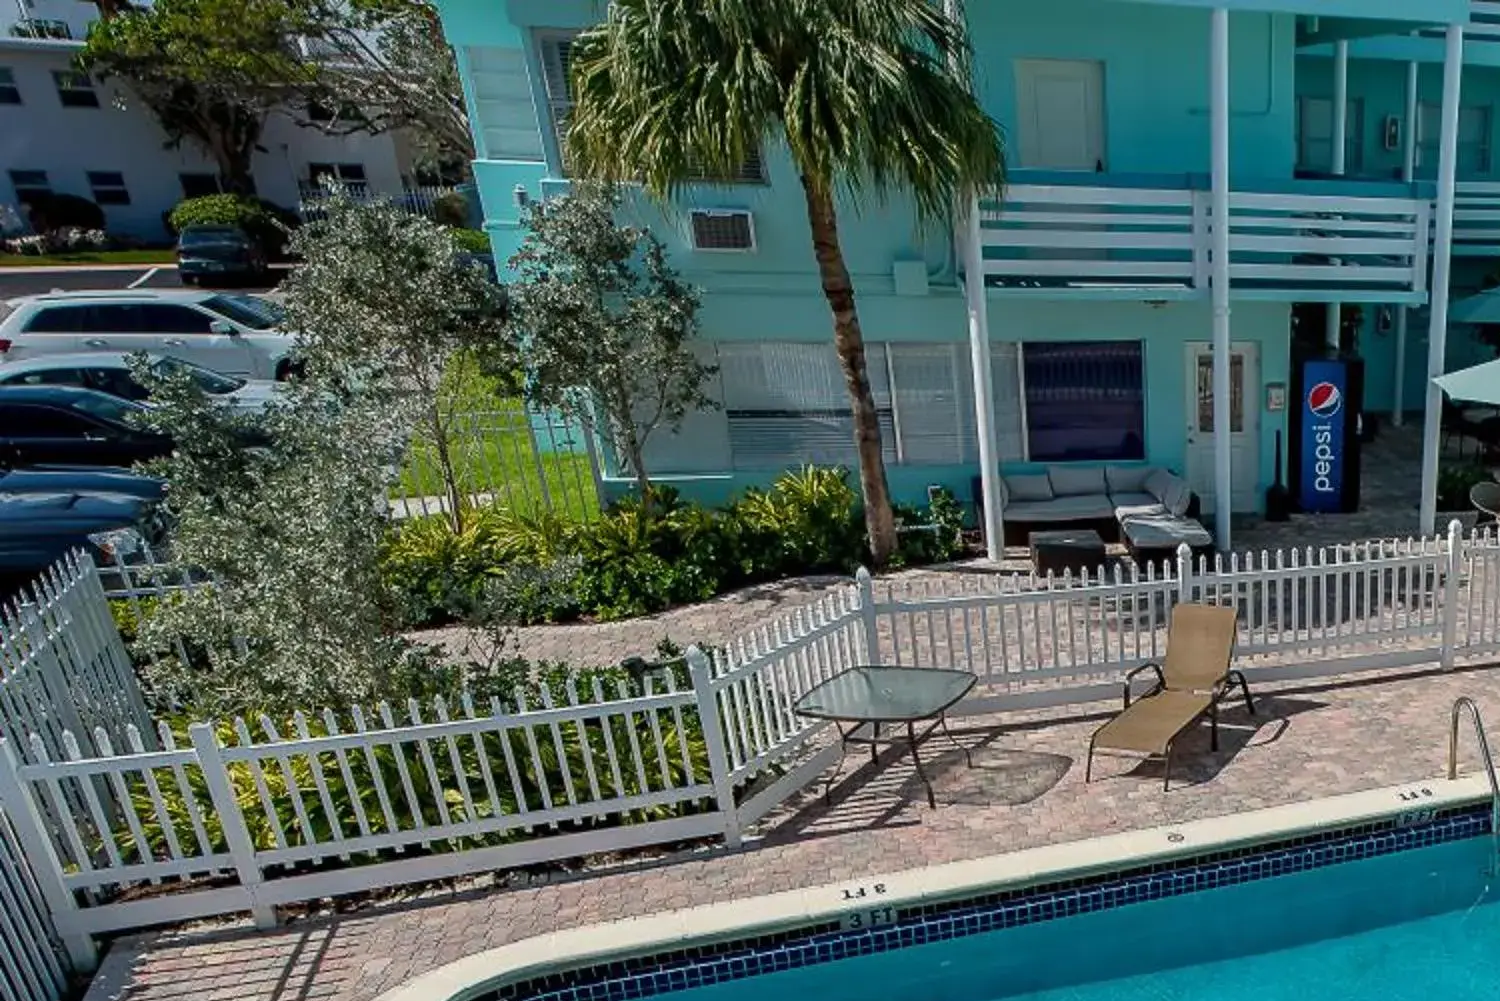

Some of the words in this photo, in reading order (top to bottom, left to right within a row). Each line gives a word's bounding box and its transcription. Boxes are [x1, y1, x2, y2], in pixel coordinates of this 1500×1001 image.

[1312, 425, 1335, 492] pepsi
[849, 912, 863, 929] 3
[869, 906, 893, 926] FT
